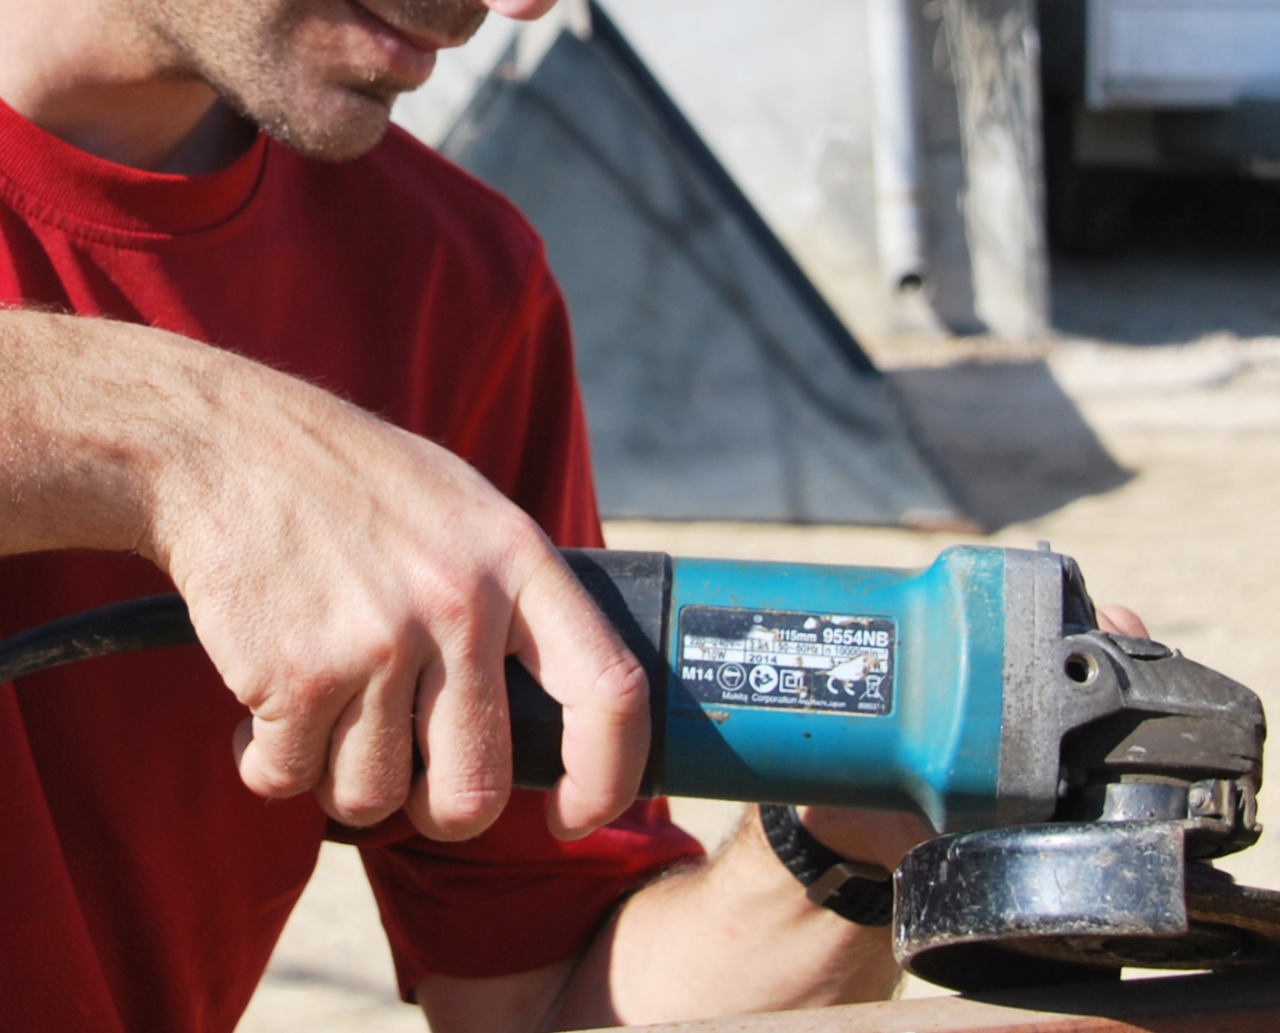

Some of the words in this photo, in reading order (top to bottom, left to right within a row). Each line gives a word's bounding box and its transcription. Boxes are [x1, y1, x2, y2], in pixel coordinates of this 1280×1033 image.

[823, 627, 890, 648] 9554NB
[749, 653, 778, 664] 2014
[682, 666, 714, 682] M14
[722, 690, 749, 702] Makita
[751, 692, 797, 705] Corporation
